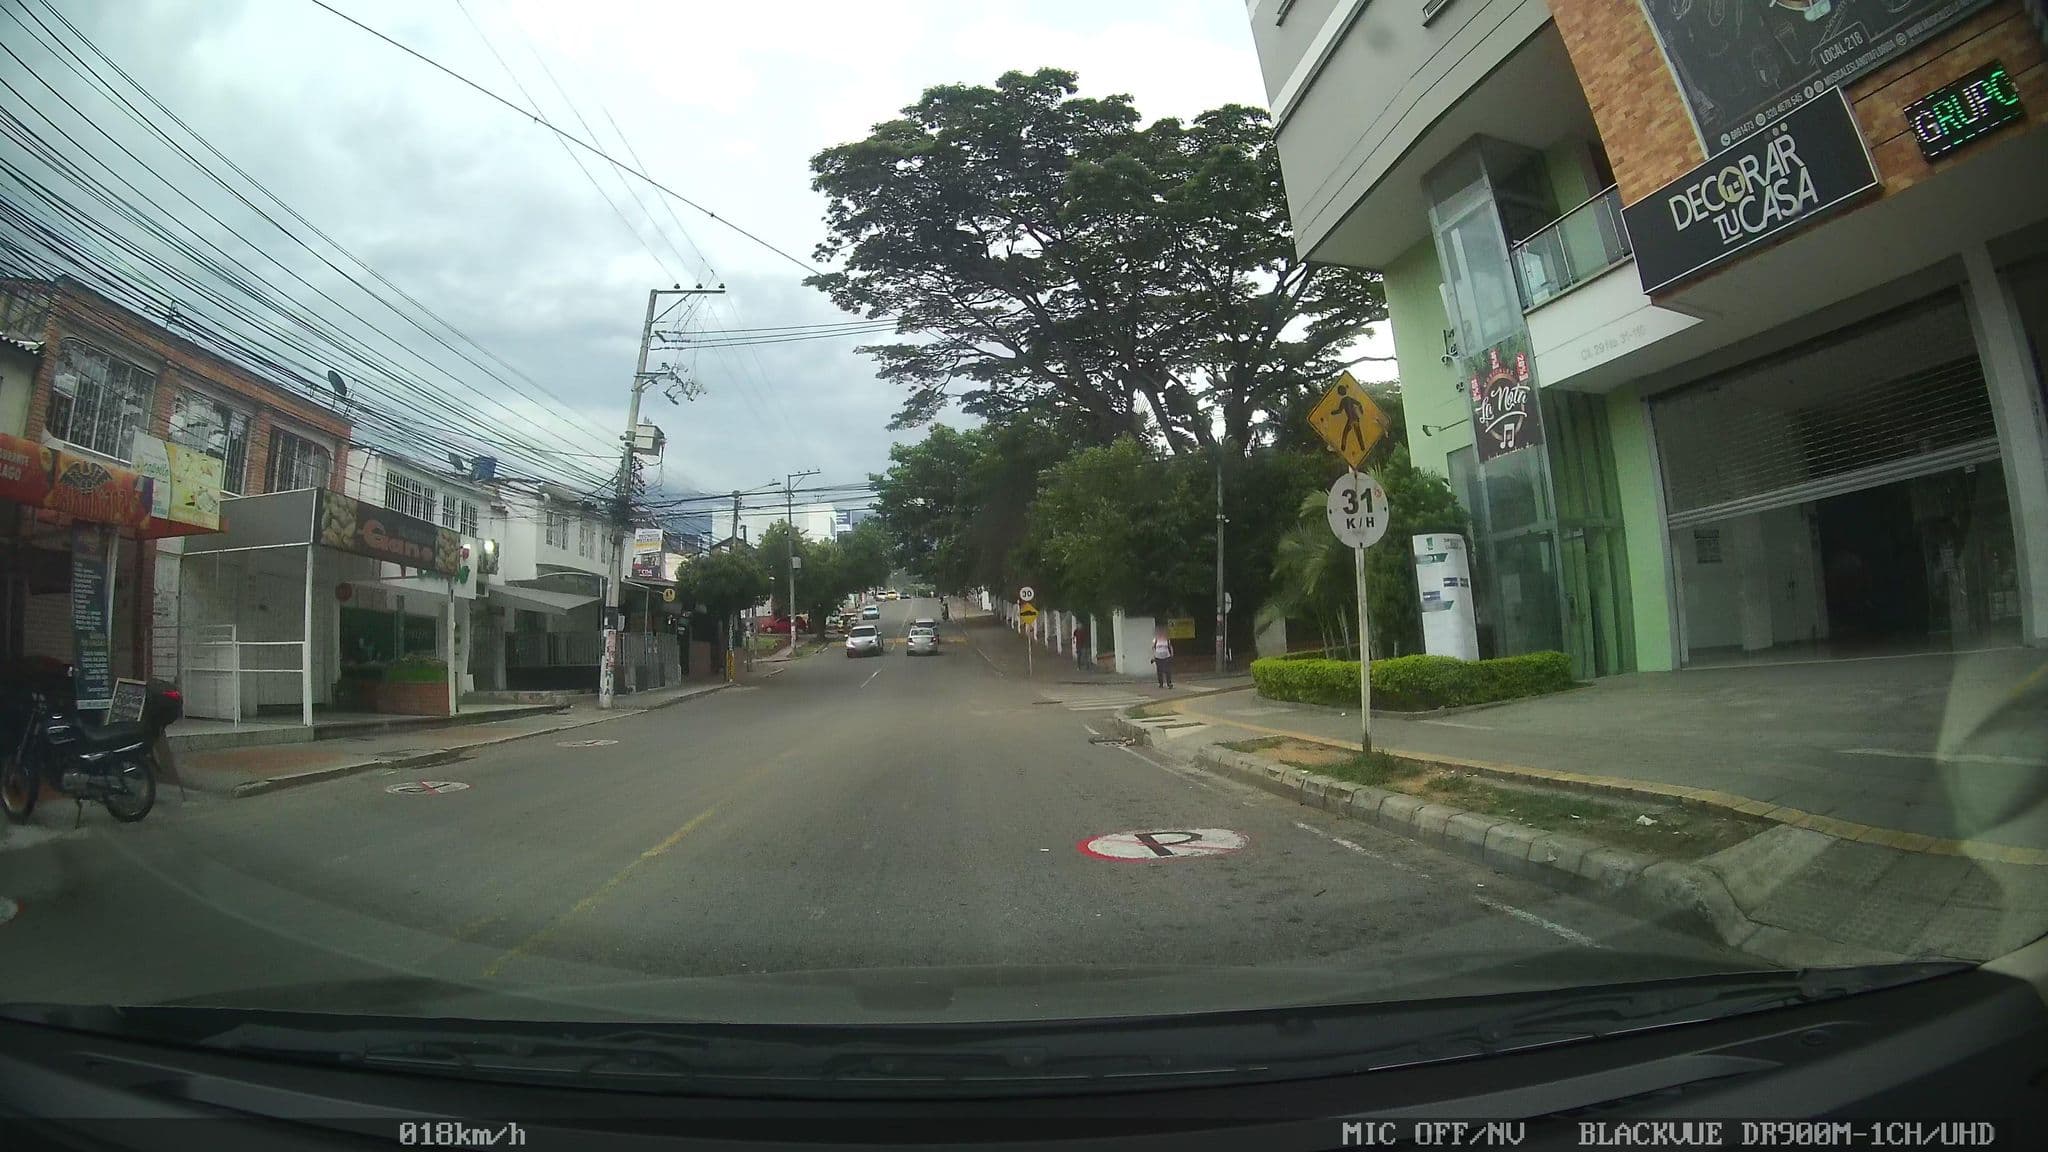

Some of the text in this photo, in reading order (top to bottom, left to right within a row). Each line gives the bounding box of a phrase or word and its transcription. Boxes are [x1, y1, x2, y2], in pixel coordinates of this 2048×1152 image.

[1819, 30, 1864, 66] LOCAL 218
[1668, 133, 1807, 232] DECORAR
[1713, 166, 1819, 241] TU CASA
[1475, 396, 1495, 423] La
[1491, 383, 1531, 411] Nota
[1342, 488, 1373, 515] 31
[1022, 590, 1032, 598] 30
